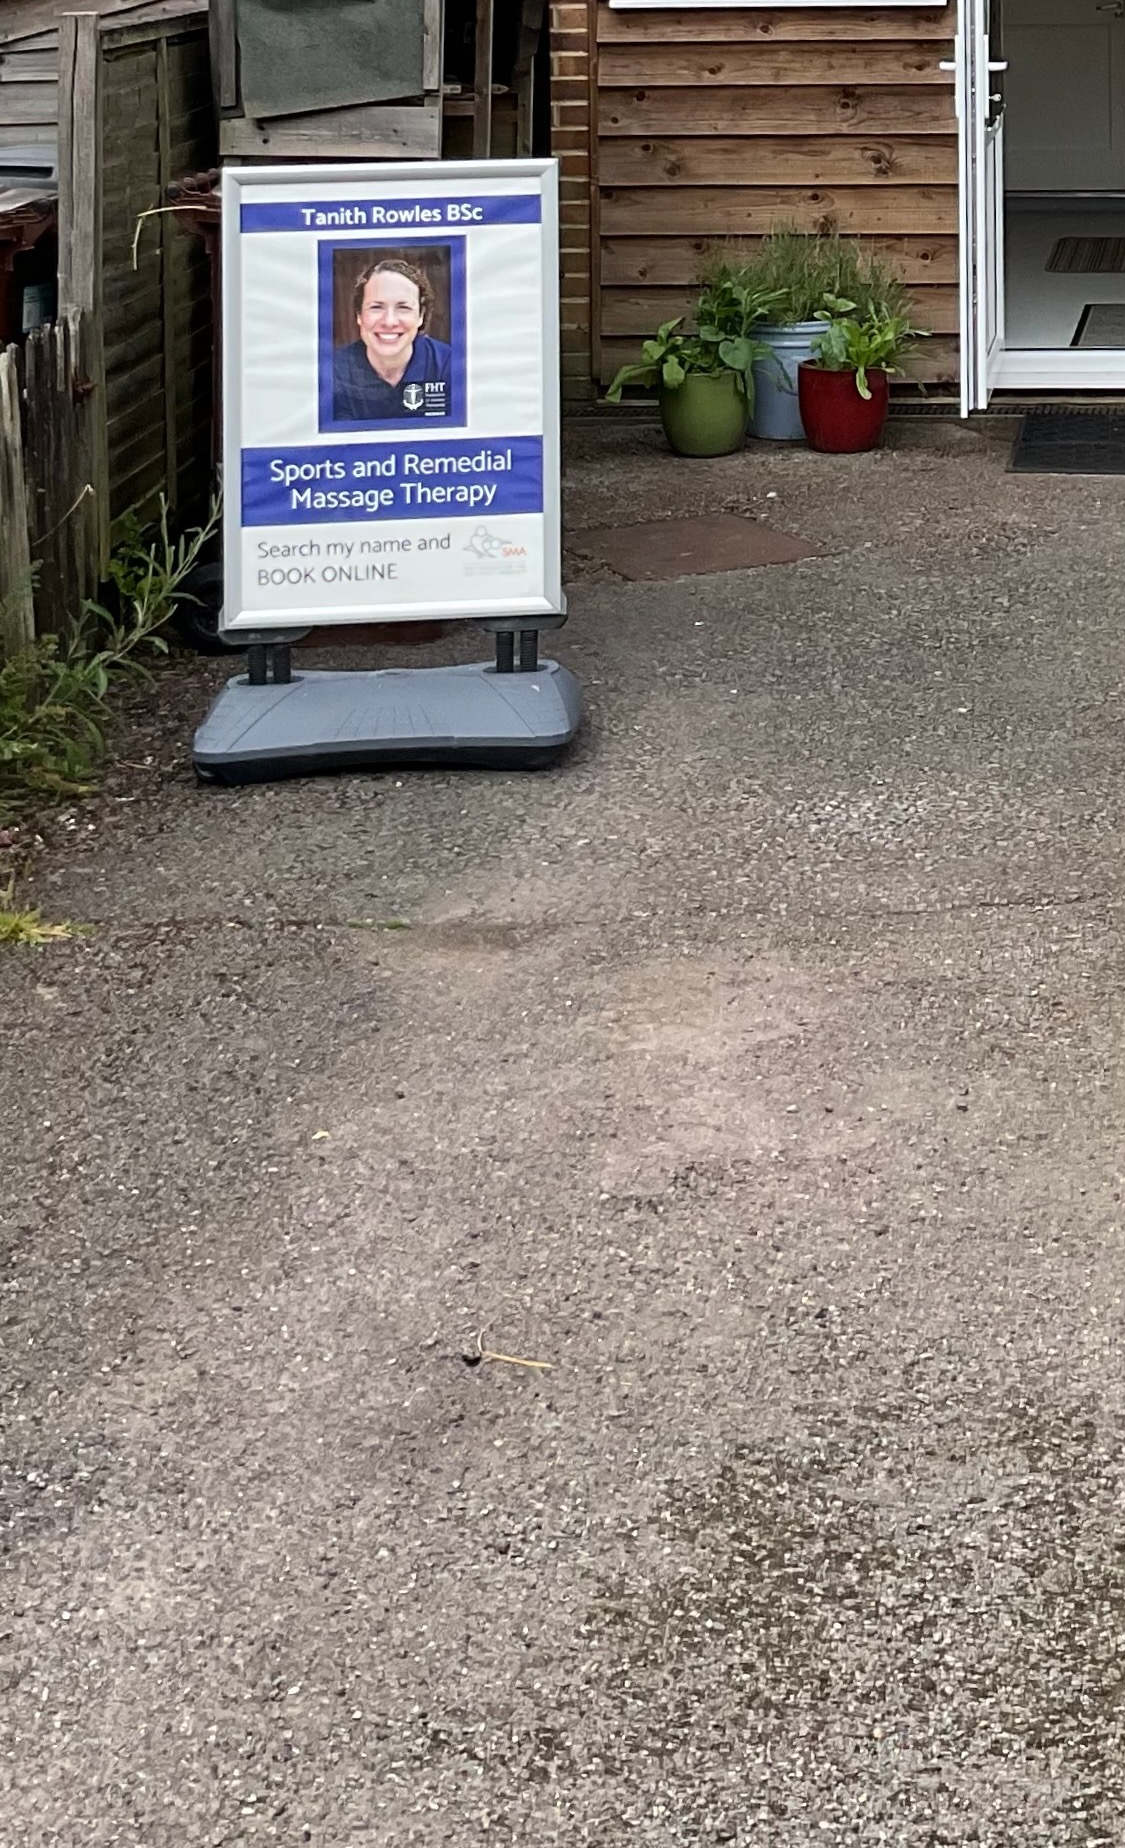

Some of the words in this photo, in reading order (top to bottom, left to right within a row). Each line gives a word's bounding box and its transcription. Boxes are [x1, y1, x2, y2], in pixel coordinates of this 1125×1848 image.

[301, 206, 367, 226] Tanith
[372, 205, 442, 224] Rowles
[447, 203, 483, 221] BSc
[425, 382, 446, 393] FHT
[270, 459, 346, 487] Sports
[352, 454, 396, 478] and
[404, 448, 512, 475] Remedial
[291, 487, 394, 512] Massage
[399, 482, 497, 507] Therapy
[257, 539, 320, 559] Search
[326, 542, 355, 559] my
[360, 539, 412, 553] name
[417, 532, 451, 551] and
[502, 546, 527, 557] SMA
[257, 567, 317, 586] BOOK
[321, 563, 398, 583] ONLINE
